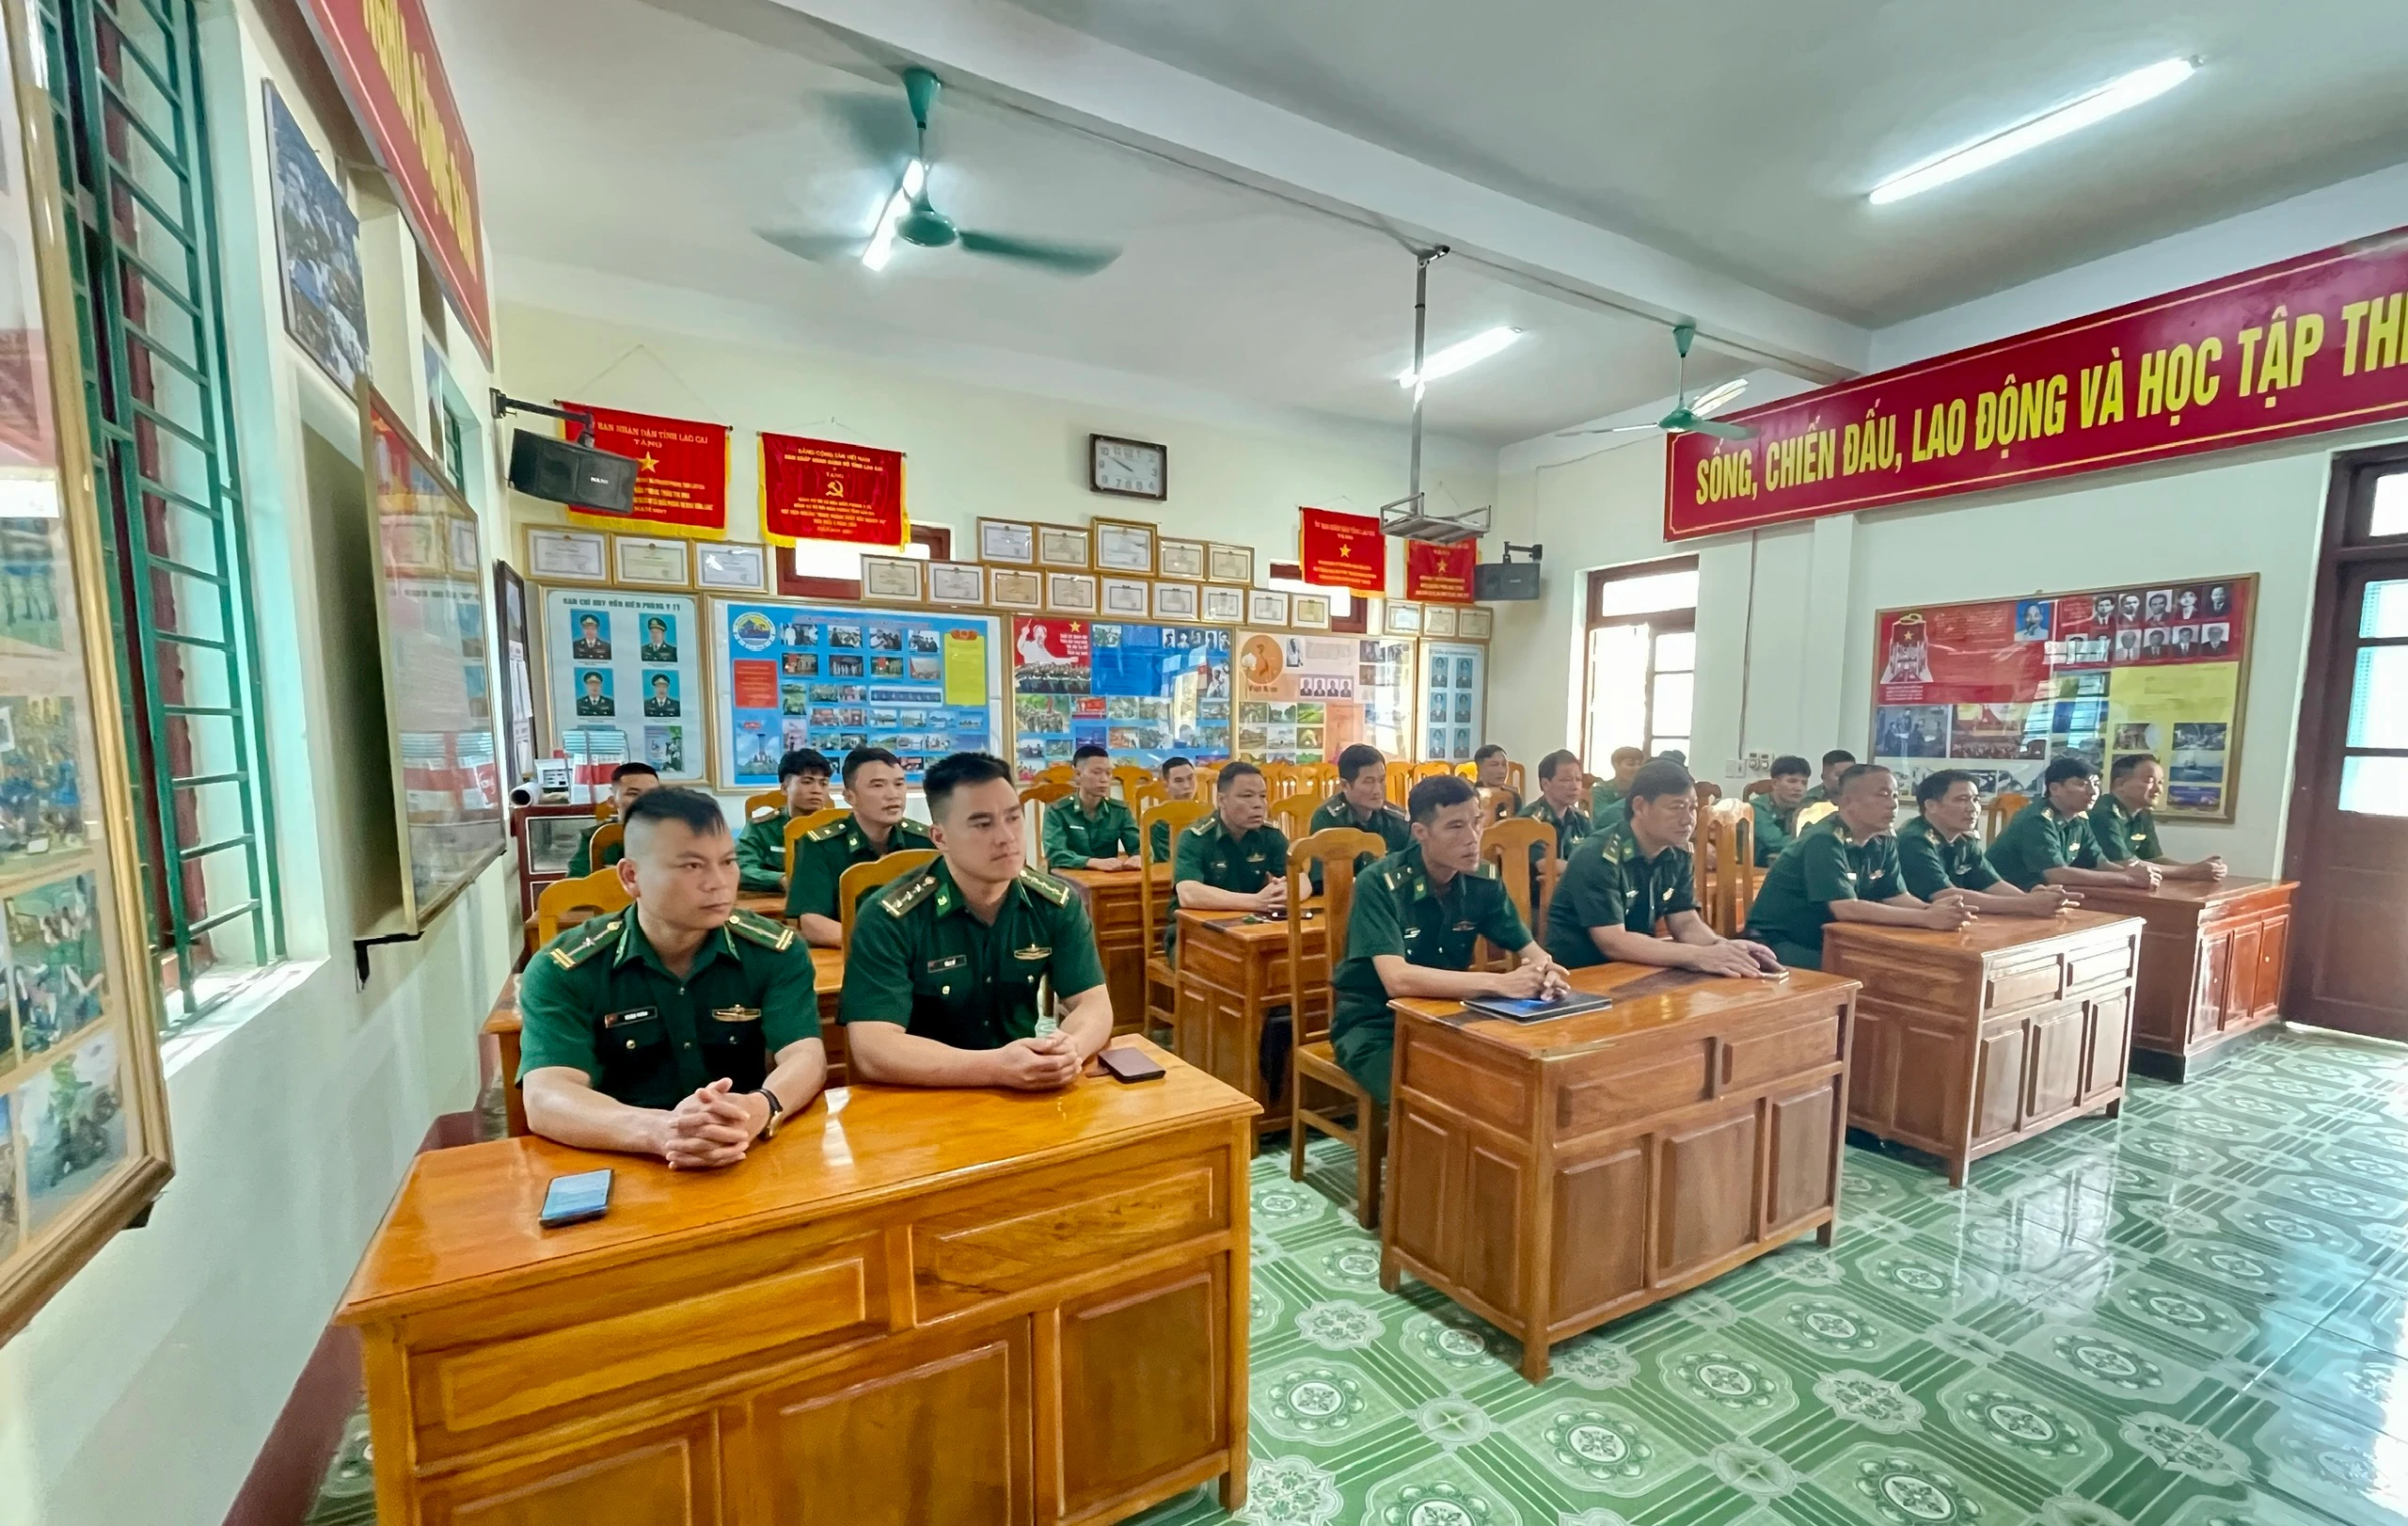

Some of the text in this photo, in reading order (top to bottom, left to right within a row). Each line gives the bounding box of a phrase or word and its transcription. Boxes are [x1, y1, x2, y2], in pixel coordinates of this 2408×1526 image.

[1696, 437, 1757, 505] SỐNG,
[1766, 415, 1836, 491] CHIẾN
[1843, 398, 1902, 476] ĐẤU,
[1911, 398, 1967, 463] LAO
[1975, 374, 2068, 459] ĐỘNG
[2080, 346, 2124, 429] VÀ
[2136, 337, 2223, 426] HỌC
[2238, 305, 2324, 408] TẬP
